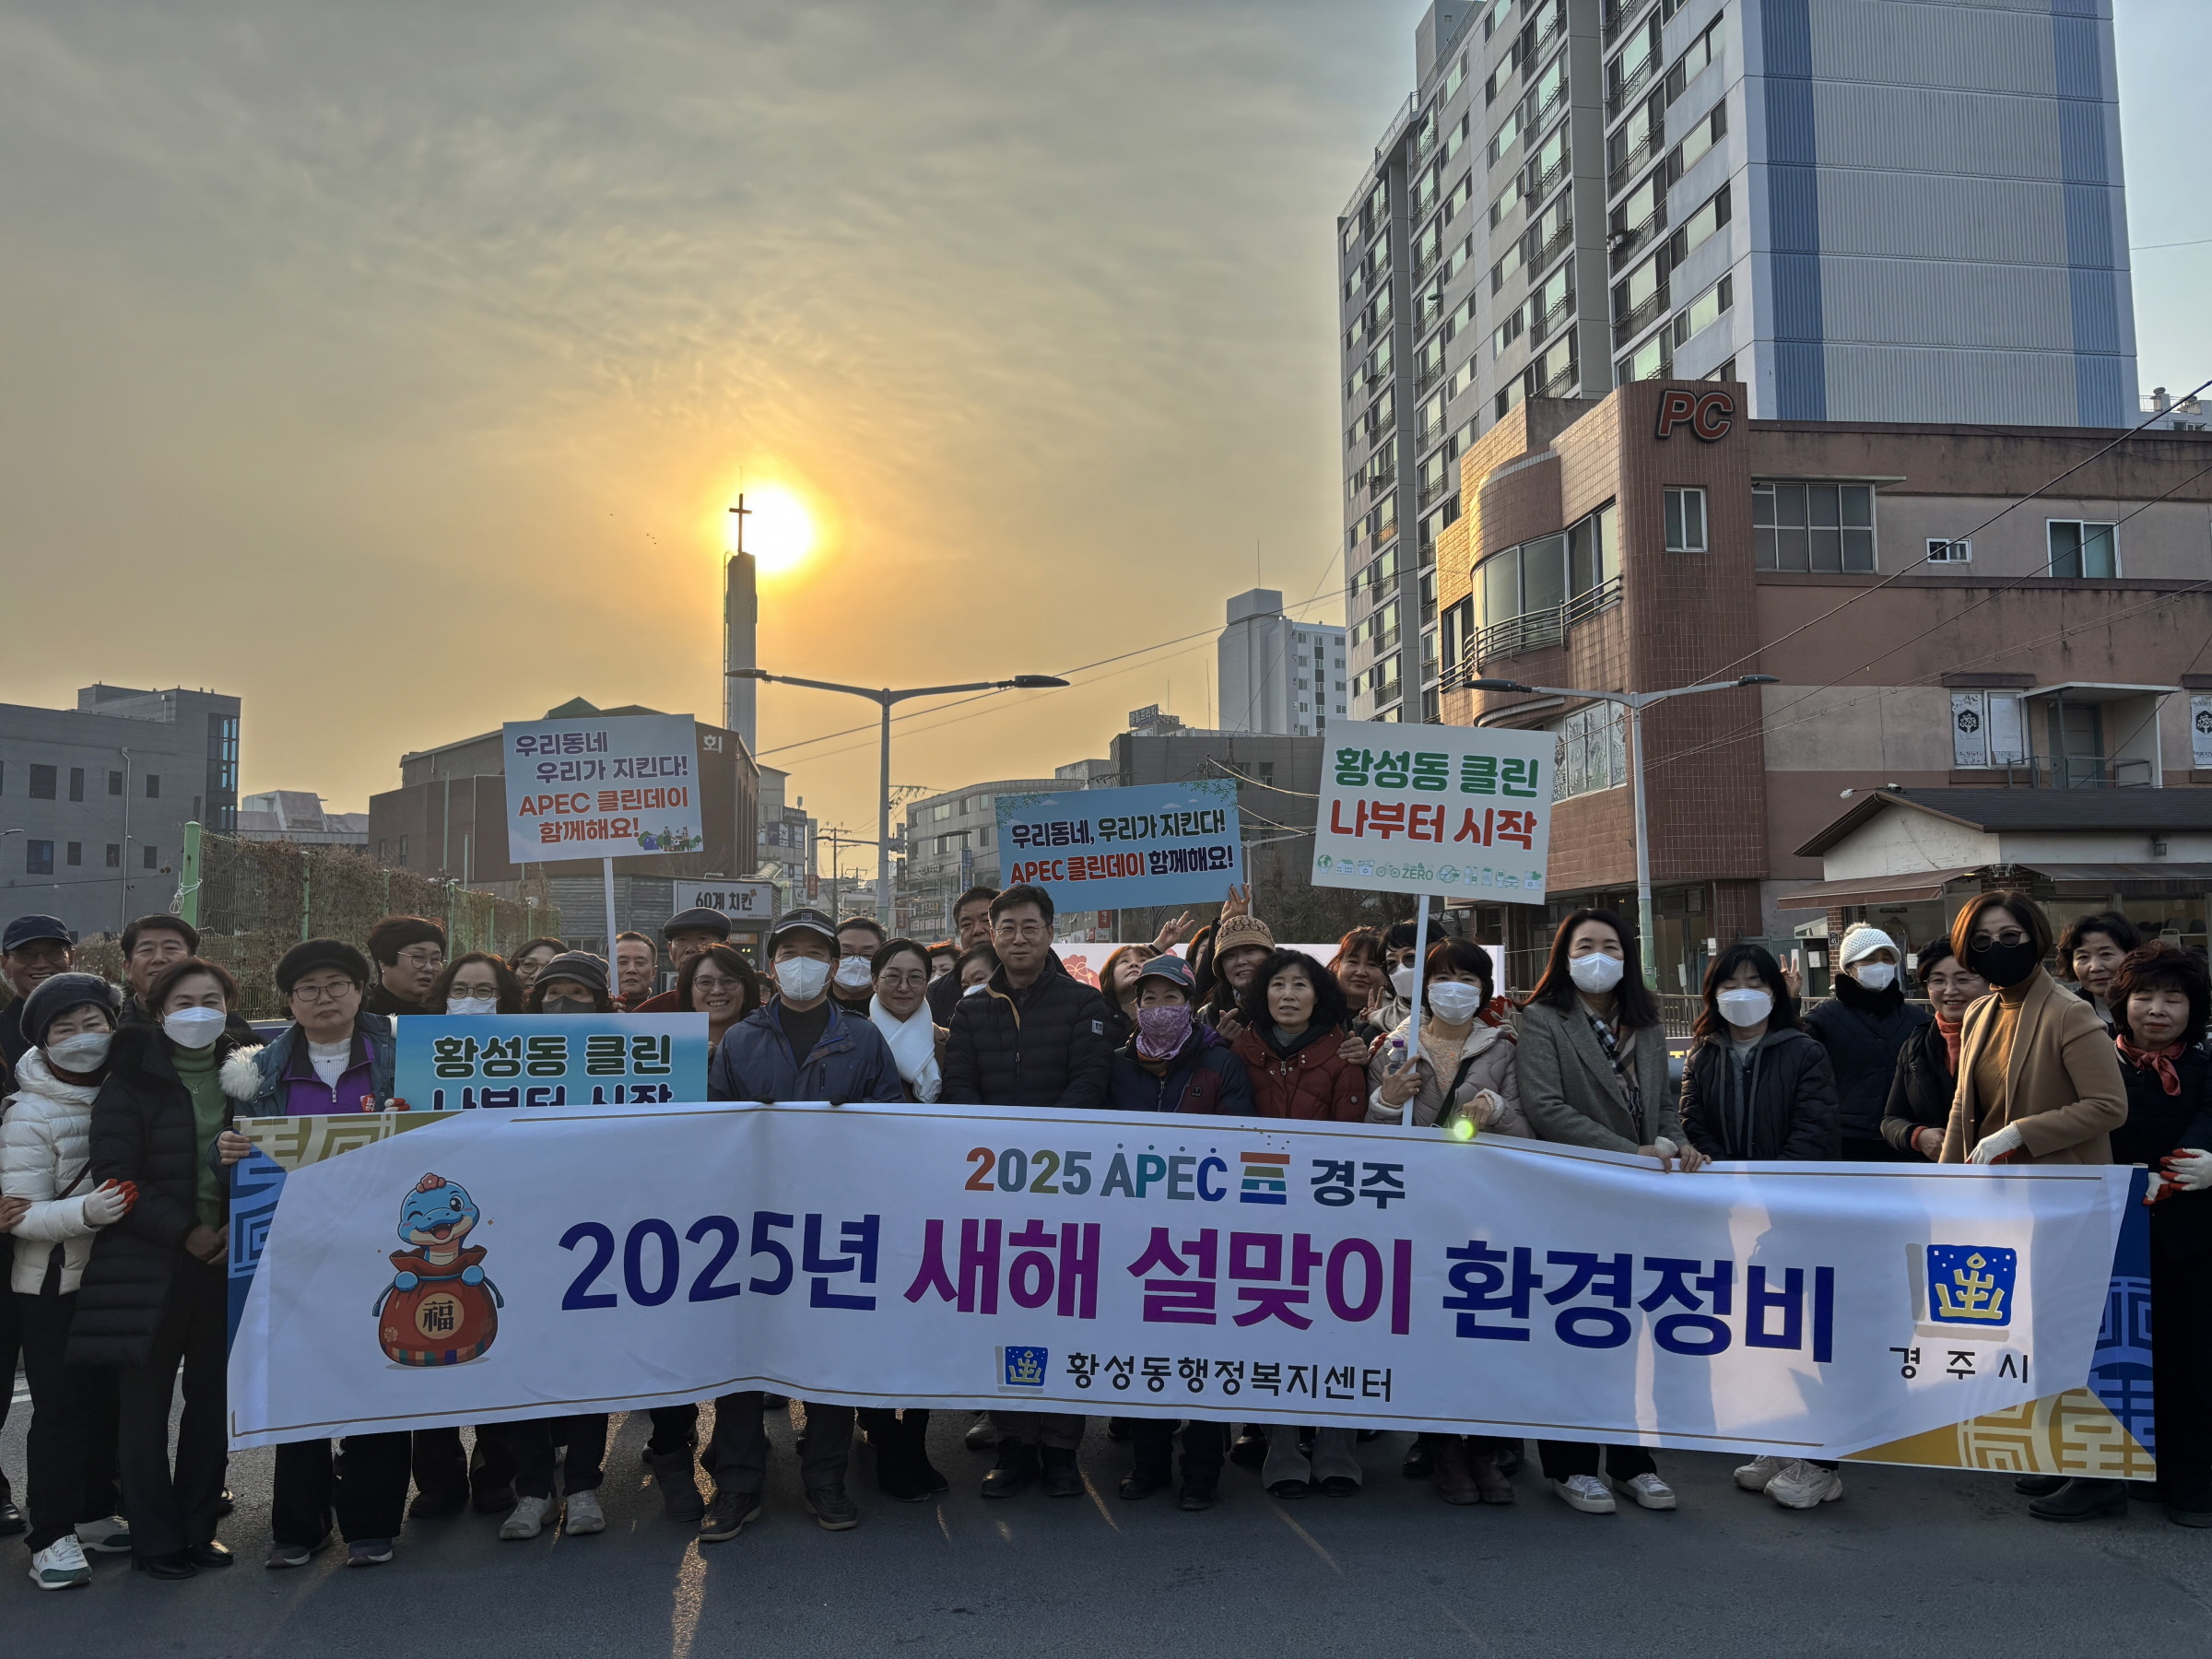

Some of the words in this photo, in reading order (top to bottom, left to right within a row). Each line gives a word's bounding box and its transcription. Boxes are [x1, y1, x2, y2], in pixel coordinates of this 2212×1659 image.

[1656, 390, 1735, 443] PC
[515, 731, 608, 758] 우리동네
[703, 735, 723, 754] 회
[535, 759, 606, 784] 우리가
[612, 755, 688, 780] 지킨다!
[1335, 747, 1450, 792] 황성동
[1460, 755, 1539, 798] 클린
[518, 792, 591, 818] APEC
[596, 786, 688, 813] 클린데이
[539, 817, 640, 843] 함께해요!
[1011, 818, 1095, 849] 우리동네,
[1098, 814, 1158, 842] 우리가
[1159, 808, 1226, 839] 지킨다!
[1330, 799, 1445, 843] 나부터
[1453, 807, 1537, 851] 시작
[1010, 858, 1064, 885] APEC
[1067, 852, 1146, 882] 클린데이
[1148, 844, 1234, 875] 함께해요!
[1402, 867, 1433, 881] ZERO
[695, 892, 725, 911] 60계
[729, 891, 753, 912] 치킨
[433, 1035, 568, 1078] 황성동
[586, 1034, 672, 1076] 클린
[964, 1147, 1091, 1194] 2025
[1100, 1145, 1228, 1202] APEC
[1310, 1159, 1406, 1209] 경주
[558, 1211, 880, 1311] 2025년
[904, 1218, 1100, 1320] 새해
[1126, 1226, 1413, 1335] 설맞이
[1441, 1240, 1835, 1364] 환경정비
[421, 1299, 454, 1333] 福
[1066, 1351, 1393, 1403] 황성동행정복지센터
